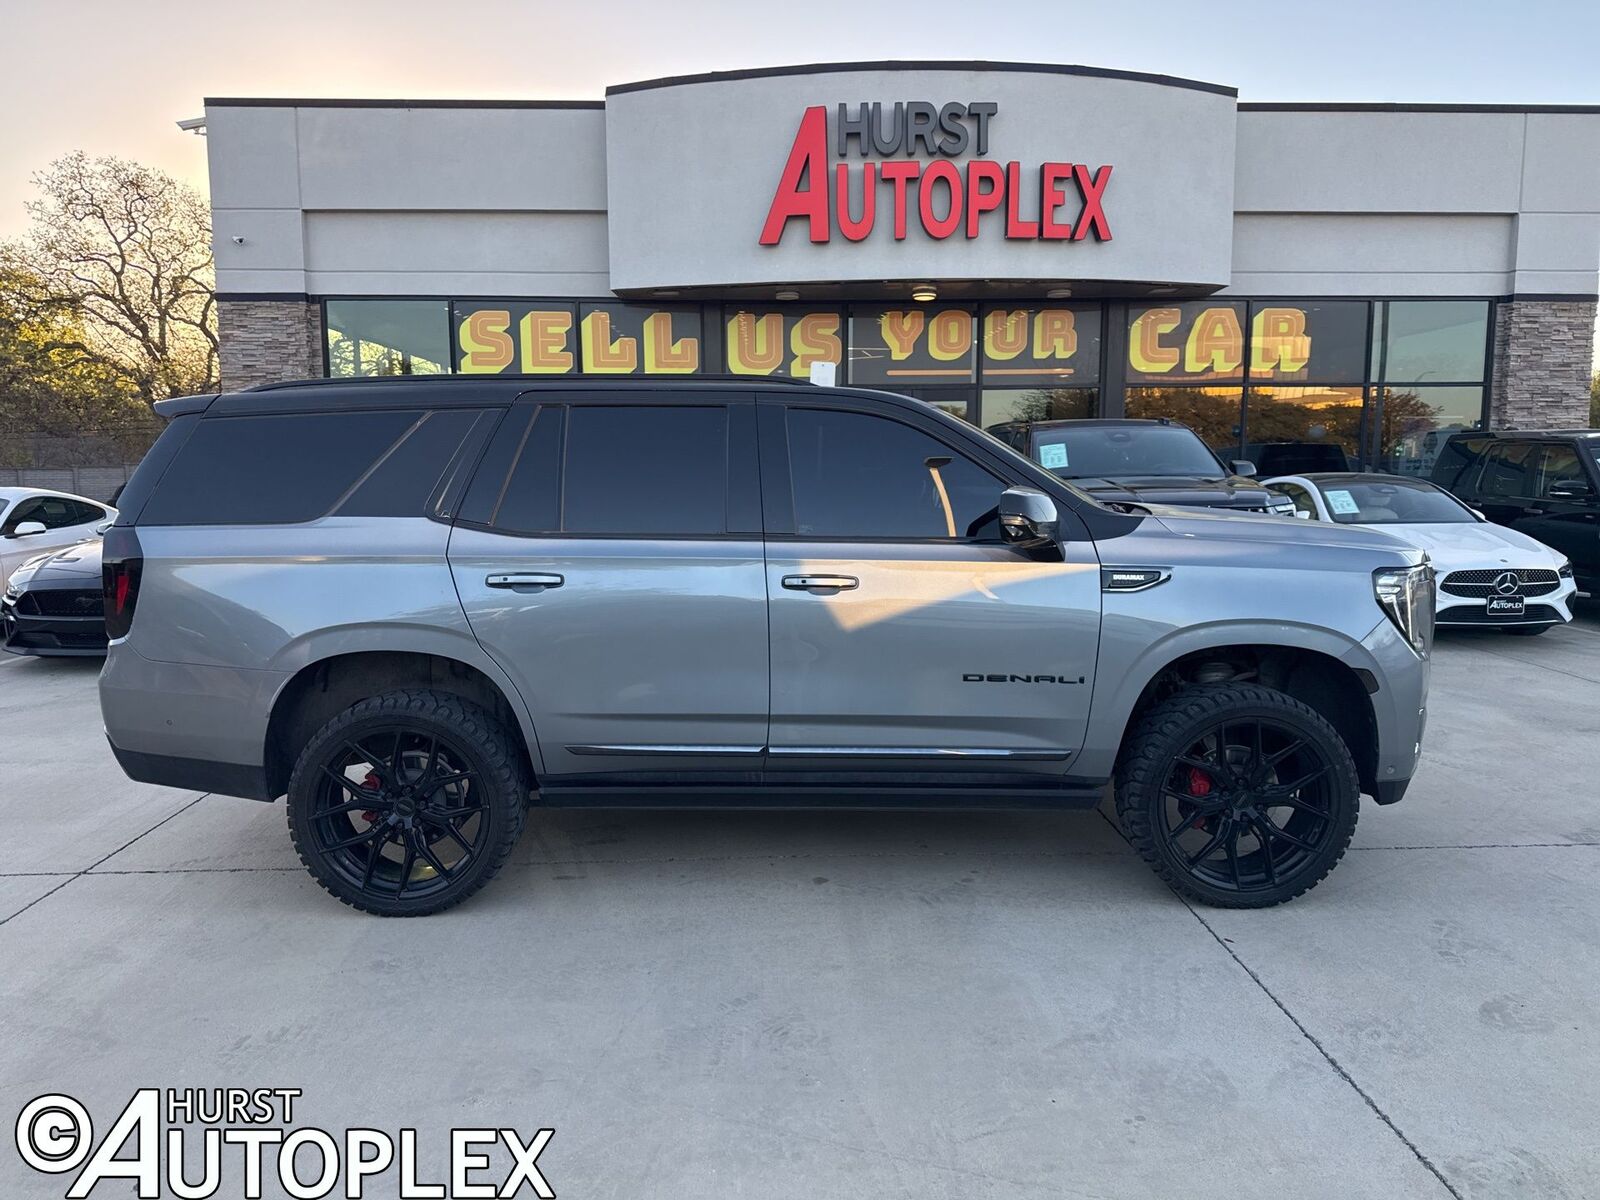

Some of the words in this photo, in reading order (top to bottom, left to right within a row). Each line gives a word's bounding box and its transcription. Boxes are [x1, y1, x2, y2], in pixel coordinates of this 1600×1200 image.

[838, 101, 998, 157] HURST
[759, 105, 1113, 246] AUTOPLEX
[459, 310, 699, 375] SELL
[727, 312, 842, 378] US
[881, 309, 1078, 361] YOUR
[1129, 308, 1311, 373] CAR
[1489, 600, 1523, 609] AUTOPLEX
[962, 673, 1085, 685] DENALI
